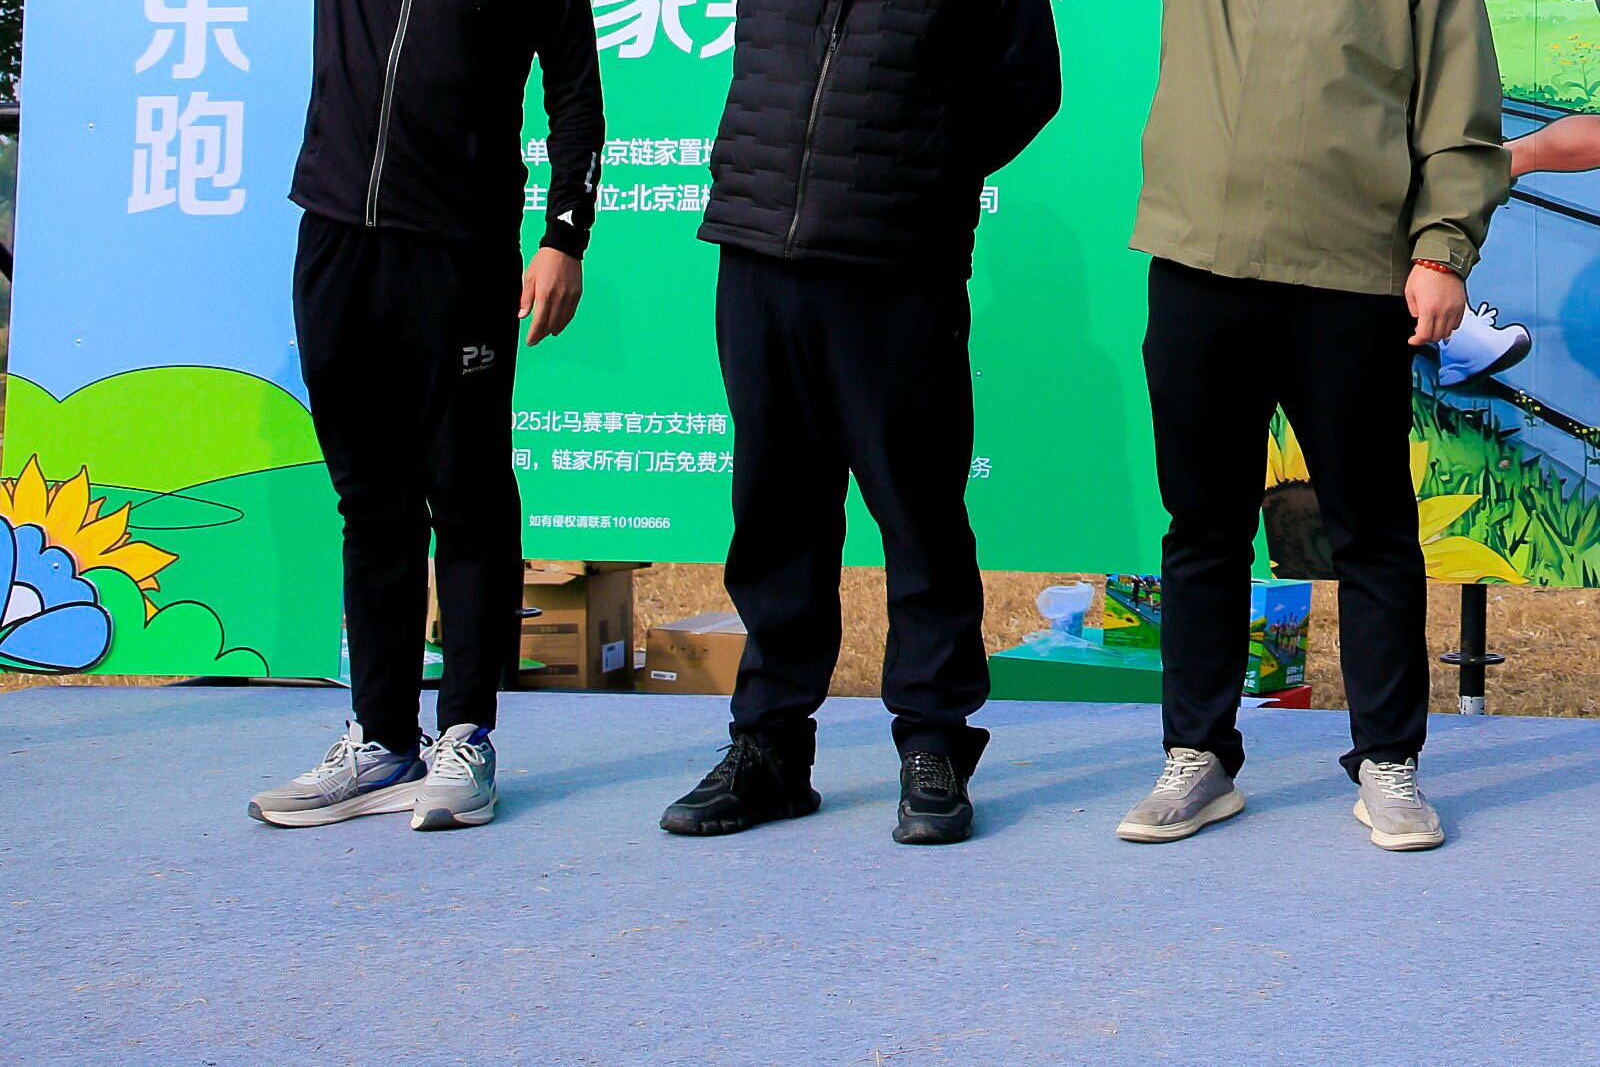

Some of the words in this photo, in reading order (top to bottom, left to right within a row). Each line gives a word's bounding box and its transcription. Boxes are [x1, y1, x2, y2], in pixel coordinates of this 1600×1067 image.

[511, 411, 727, 435] 25北马赛事官方支持商
